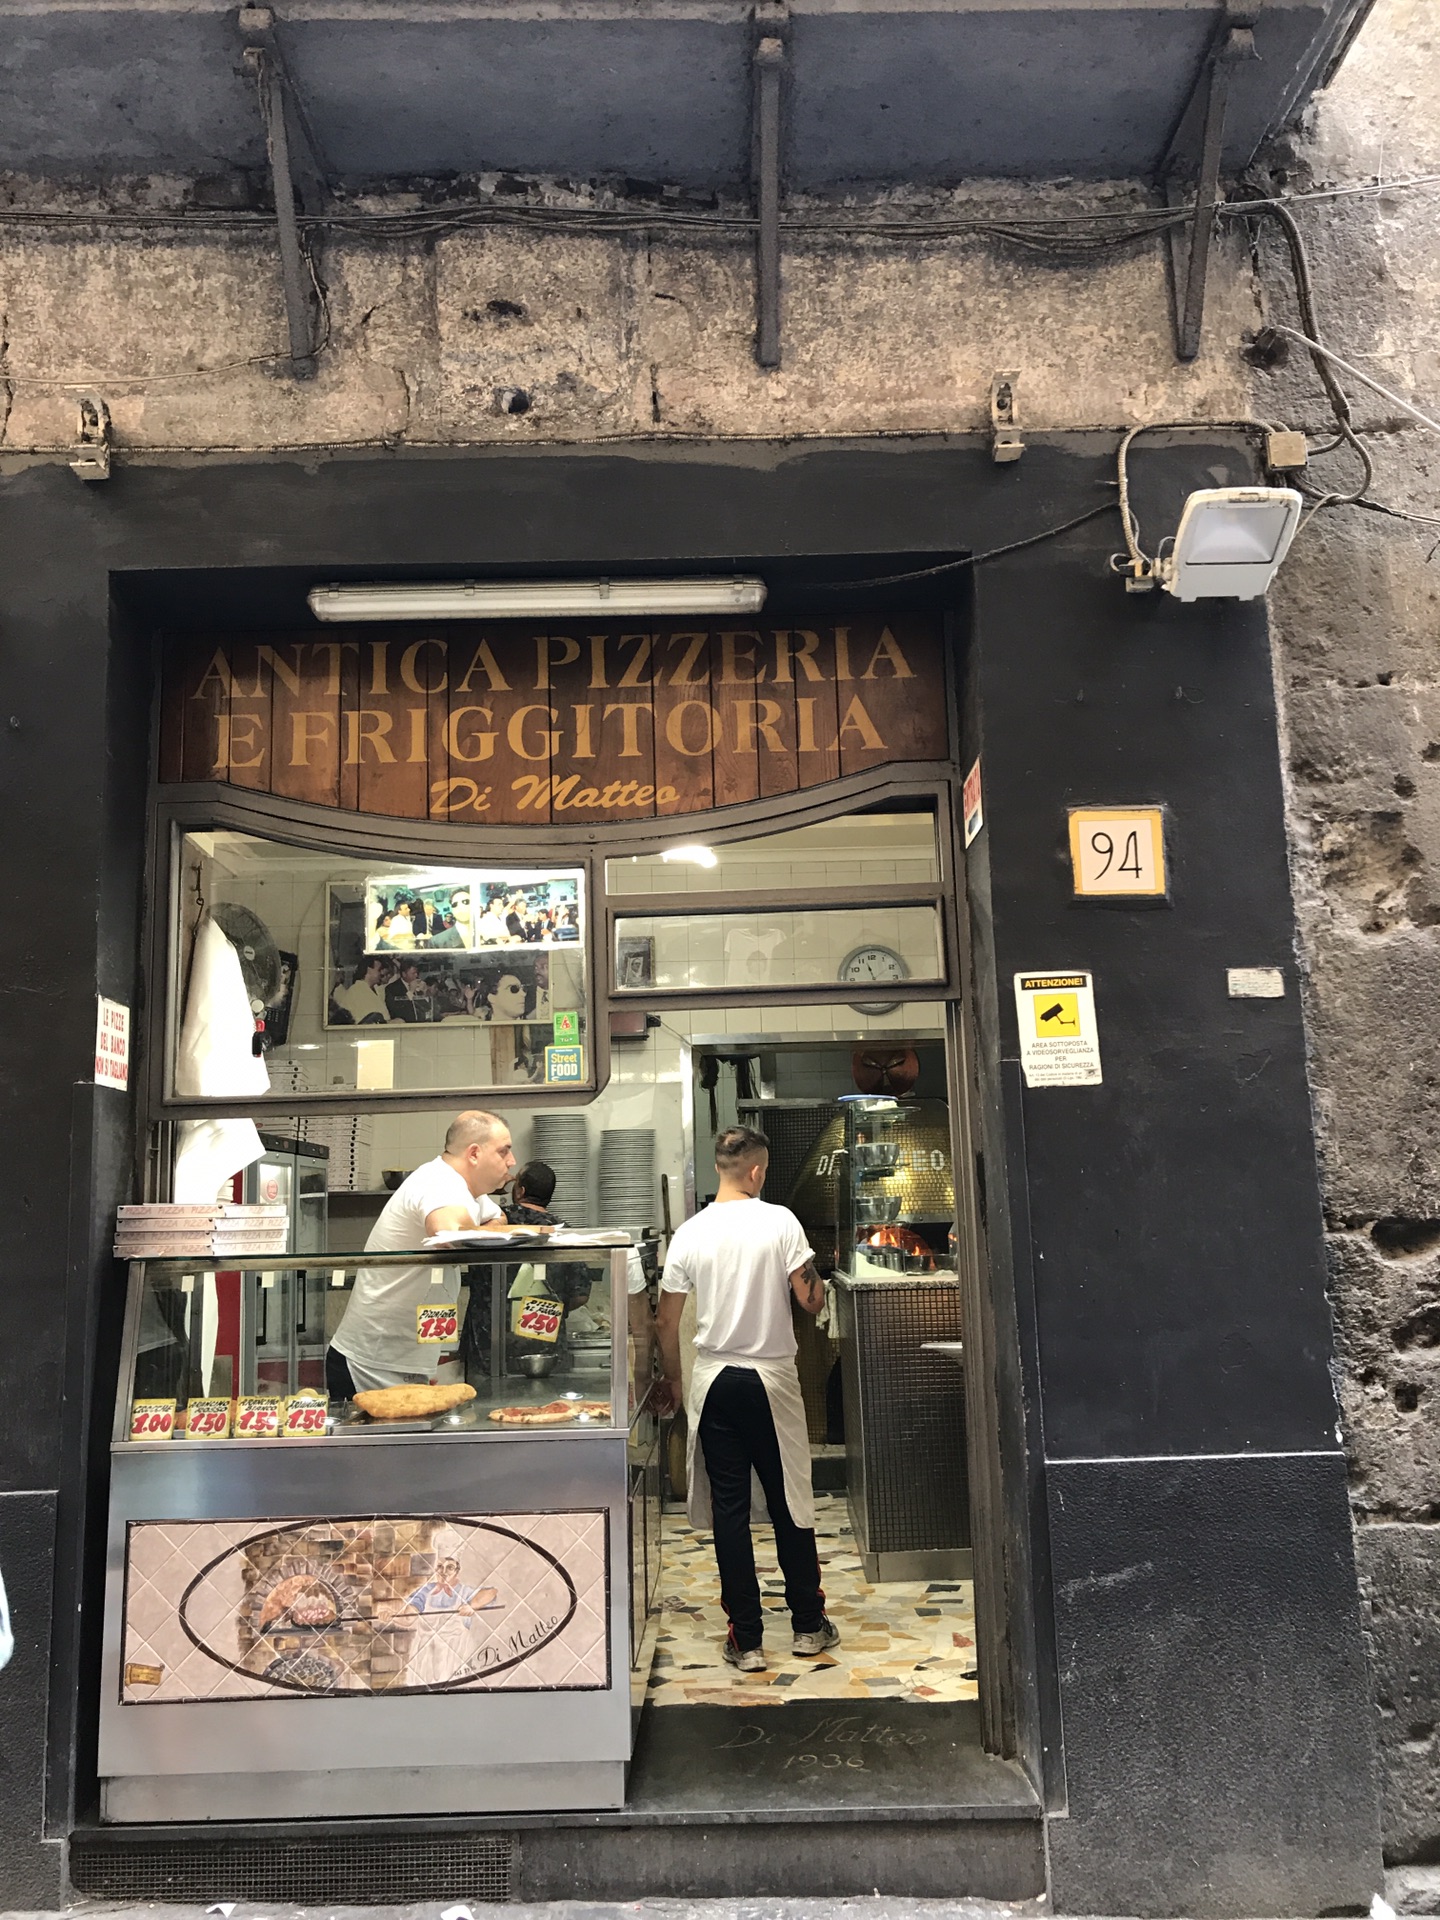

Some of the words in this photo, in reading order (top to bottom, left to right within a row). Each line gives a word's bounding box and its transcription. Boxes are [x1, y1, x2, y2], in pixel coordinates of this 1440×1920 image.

[190, 638, 513, 699] ANTICA
[532, 625, 917, 690] PIZZERIA
[212, 713, 266, 769] E
[288, 693, 888, 768] FRIGGITORIA
[430, 777, 492, 814] Di
[511, 774, 680, 811] Matteo
[1090, 830, 1143, 881] 94
[1024, 977, 1083, 988] ATTENZIONE!
[111, 1010, 124, 1032] PIZZE
[1032, 1047, 1094, 1056] VIDEOSORVEGLIANZA
[1049, 1040, 1088, 1048] SOTTOPOSTA
[551, 1053, 578, 1063] Street
[551, 1063, 578, 1076] FOOD
[158, 1206, 184, 1214] PIZZA
[191, 1206, 217, 1214] PIZZA
[421, 1317, 457, 1338] 1.50
[521, 1311, 558, 1333] 1.50
[131, 1413, 172, 1434] 1.00
[477, 1645, 502, 1667] Di
[508, 1616, 558, 1657] Matteo
[713, 1724, 777, 1750] Di
[790, 1716, 927, 1748] Matteo
[782, 1753, 865, 1770] 1936
